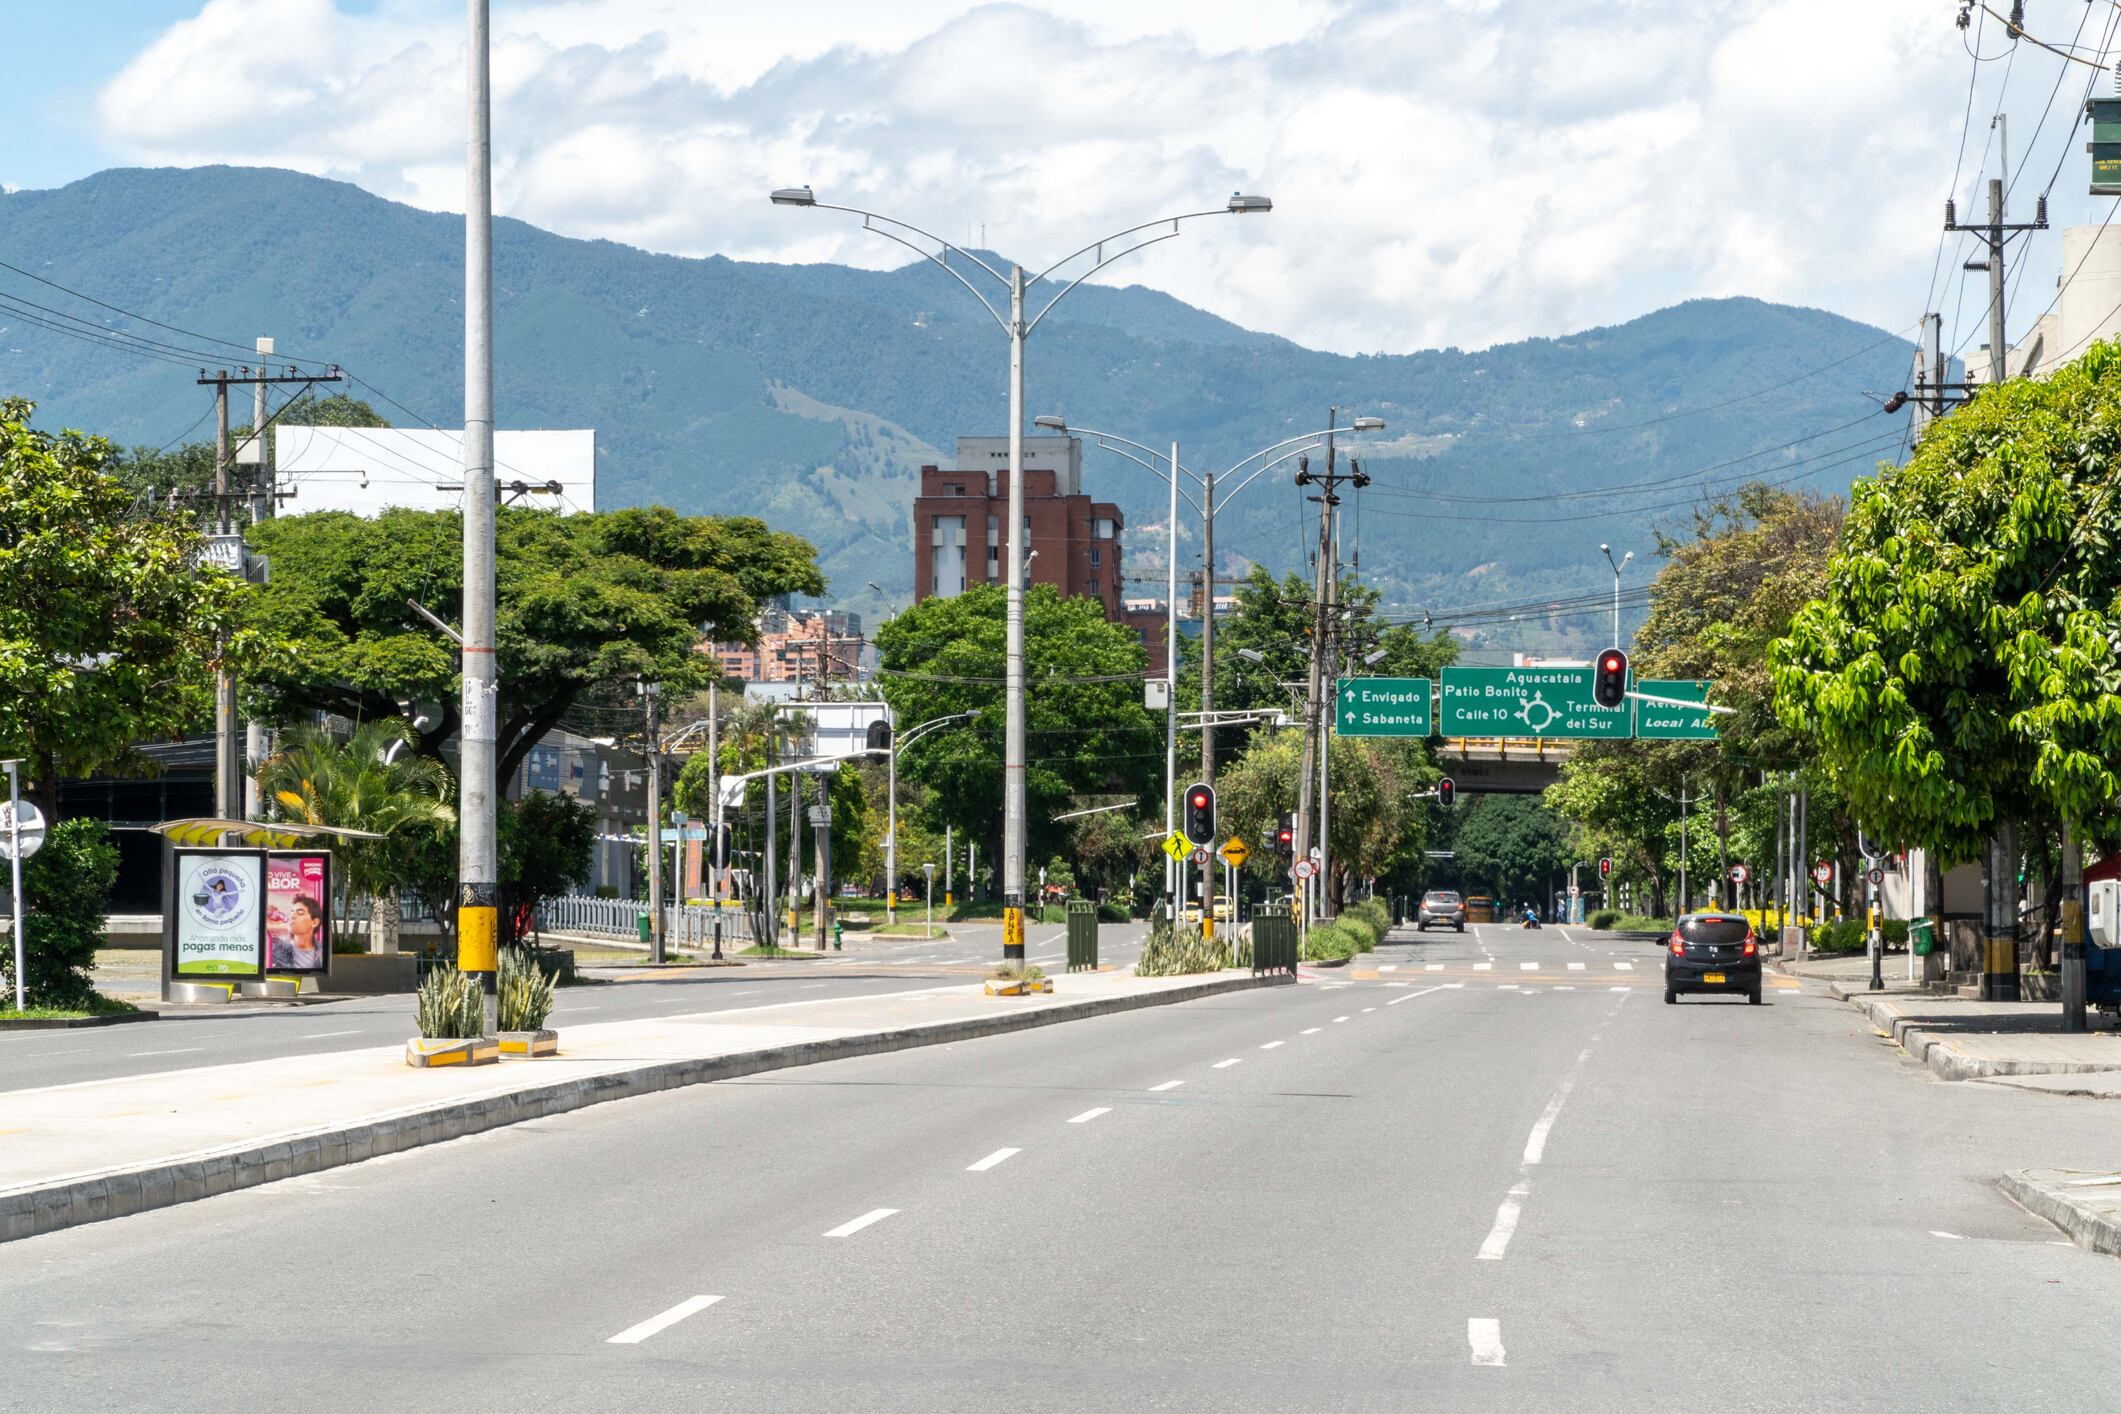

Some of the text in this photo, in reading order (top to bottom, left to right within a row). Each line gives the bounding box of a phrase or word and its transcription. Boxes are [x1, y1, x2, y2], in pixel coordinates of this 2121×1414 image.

[1505, 671, 1582, 686] Aguacatala
[1445, 685, 1528, 697] Patio Bonito
[1362, 690, 1420, 705] Envigado
[1362, 712, 1423, 724] Sabaneta
[1456, 708, 1508, 720] Calle 10
[1566, 717, 1613, 729] del Sur
[1645, 717, 1684, 728] Local
[202, 867, 217, 877] Olla
[274, 871, 292, 879] VIVE
[195, 908, 203, 916] en
[189, 934, 229, 942] Ahorrando
[182, 943, 254, 953] pagas menos
